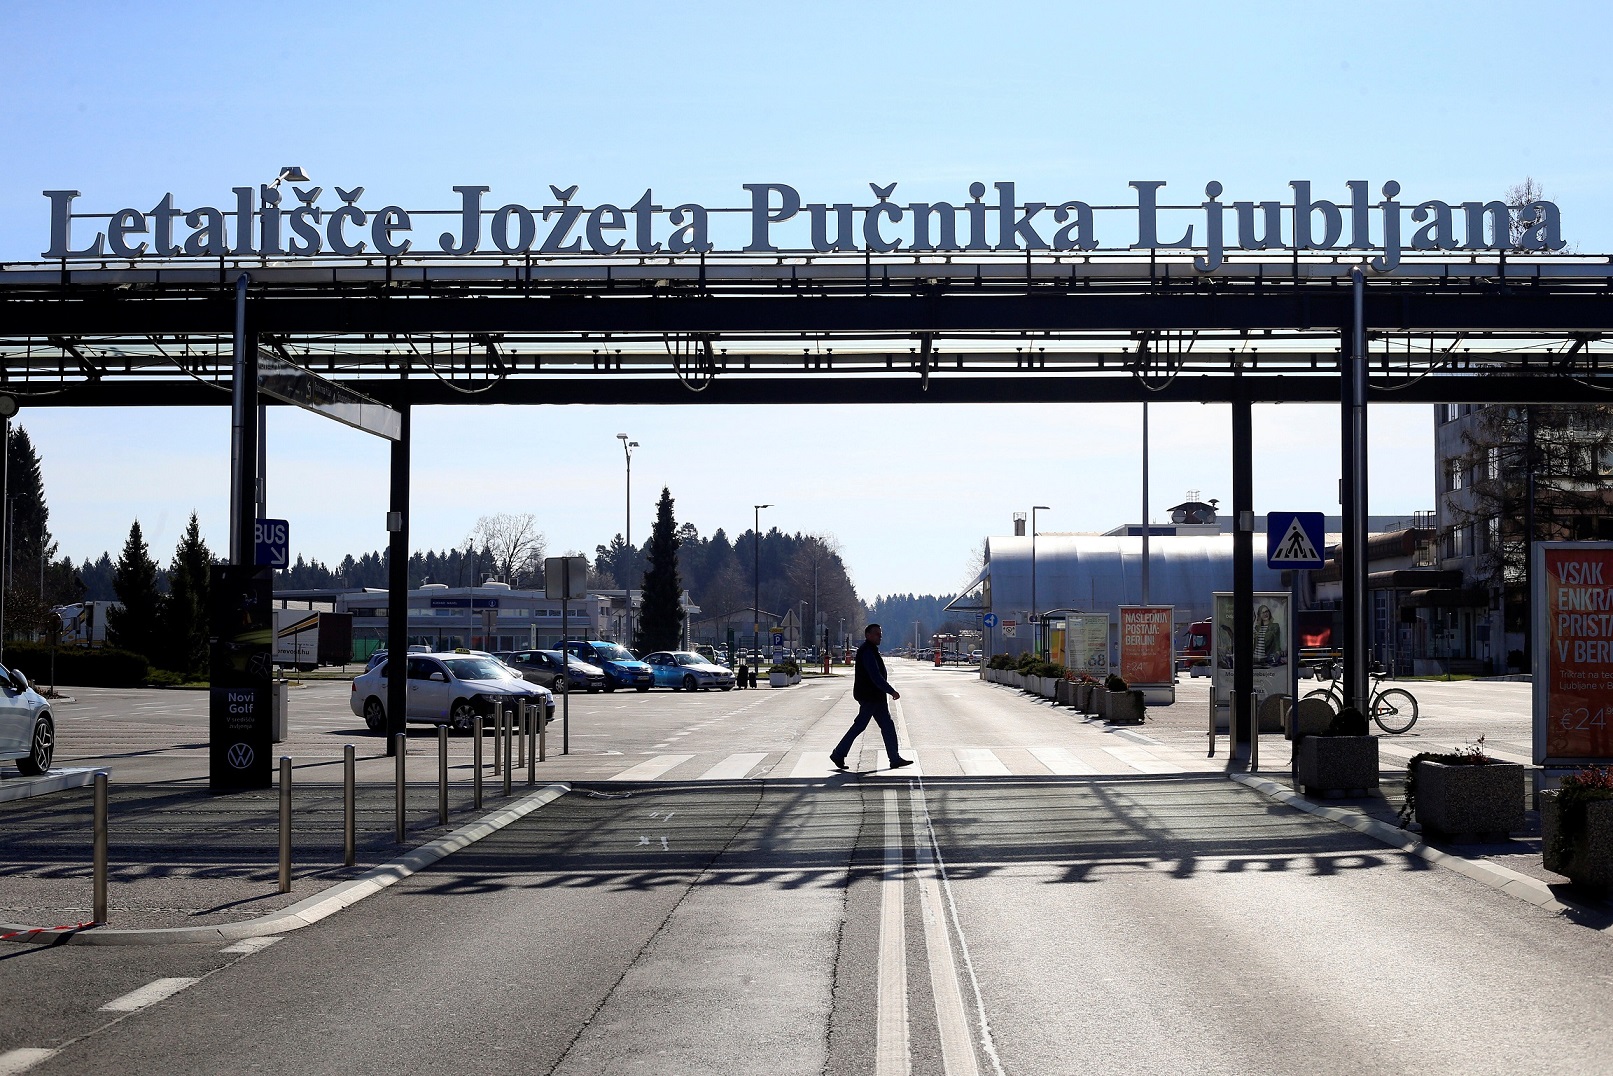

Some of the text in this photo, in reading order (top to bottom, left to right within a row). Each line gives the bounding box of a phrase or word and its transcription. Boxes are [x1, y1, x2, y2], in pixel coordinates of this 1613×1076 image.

[41, 180, 1567, 273] Letališče Jožeta Pučnika Ljubljana
[255, 524, 286, 544] BUS
[1557, 562, 1604, 585] VSAK
[1125, 612, 1168, 623] NASLEDNJA
[1125, 624, 1160, 634] POSTAJA:
[1125, 635, 1155, 645] BERLIN!
[1557, 640, 1569, 663] V
[1560, 670, 1586, 679] Trikrat
[1560, 682, 1597, 691] Ljubljane
[228, 692, 254, 702] Novi
[229, 703, 254, 713] Golf
